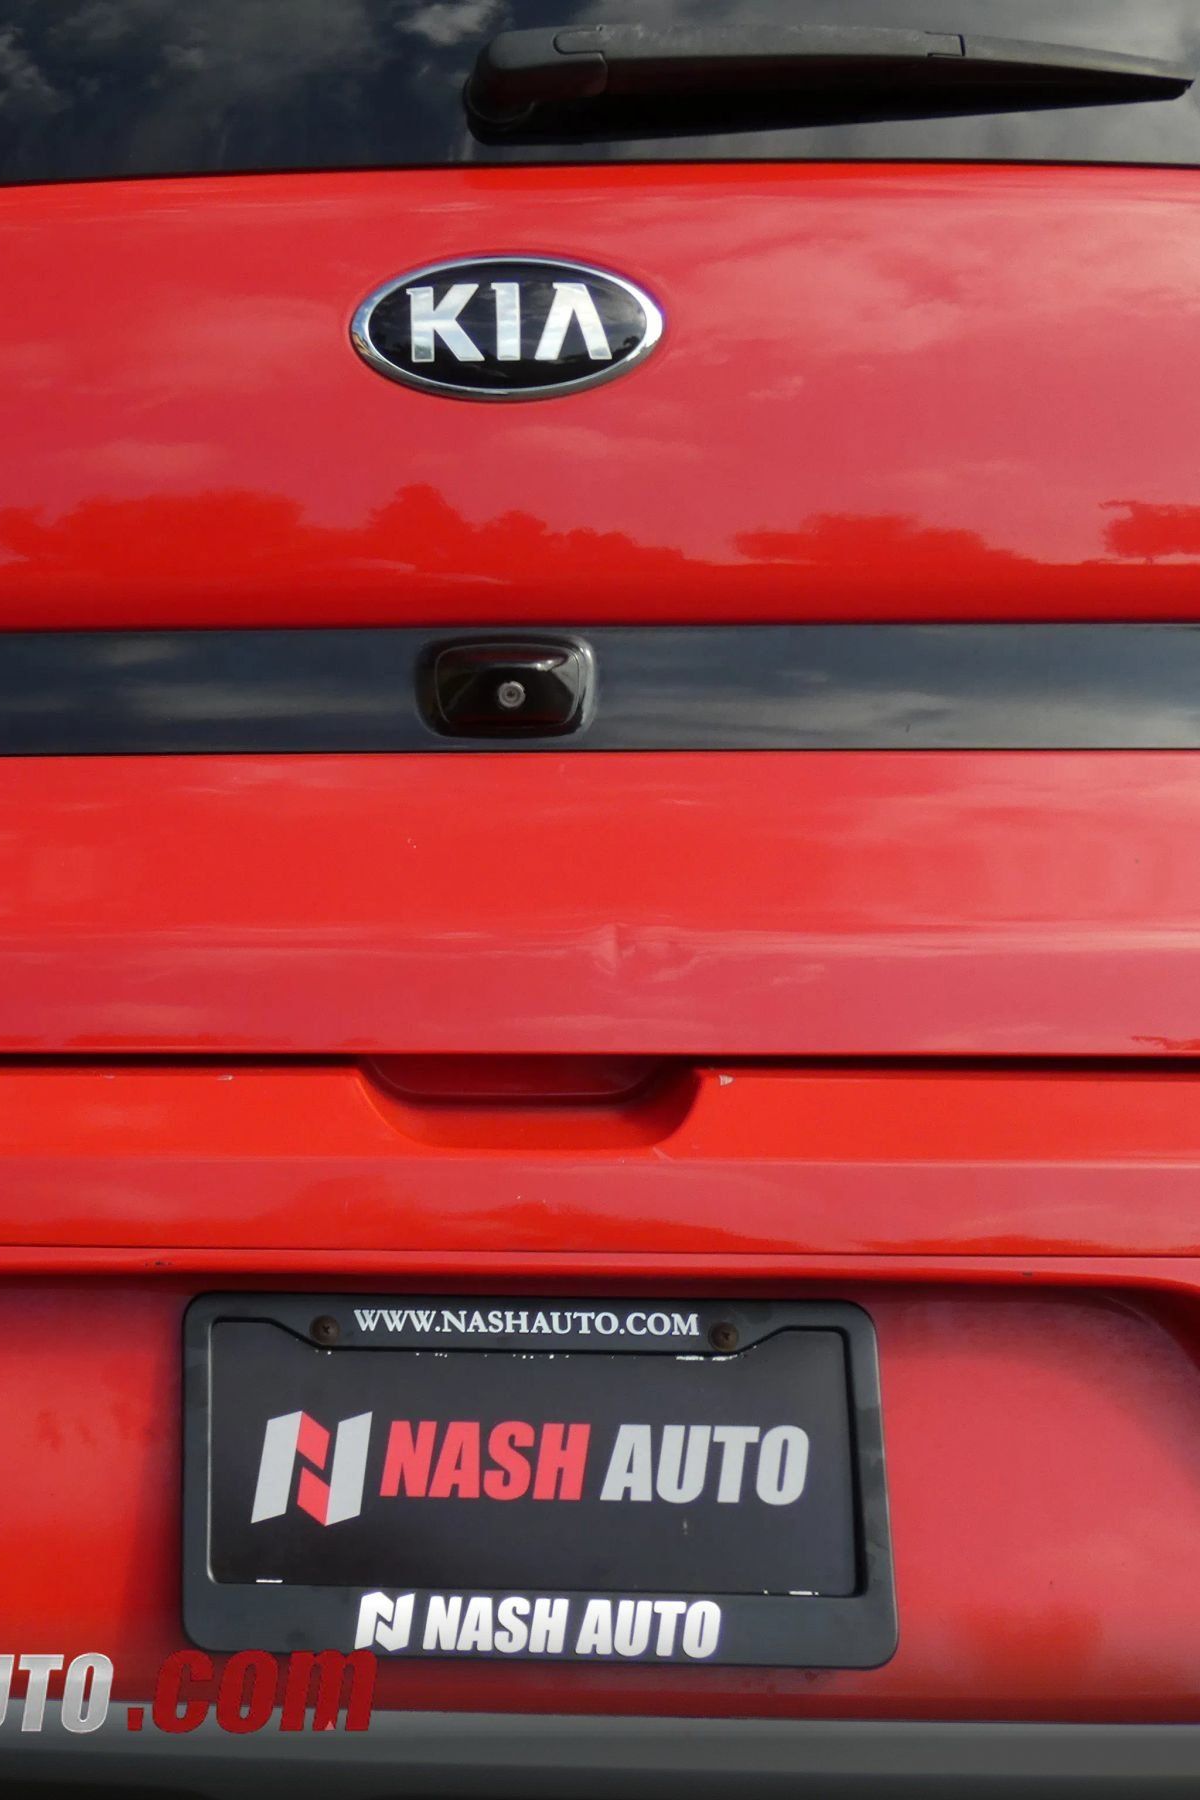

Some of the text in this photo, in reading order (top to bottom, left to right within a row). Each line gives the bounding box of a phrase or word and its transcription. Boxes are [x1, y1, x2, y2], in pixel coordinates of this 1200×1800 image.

[406, 282, 613, 362] KIA
[354, 1309, 700, 1336] WWW.NASHAUTO.COM
[379, 1420, 591, 1501] NASH
[600, 1424, 810, 1505] AUTO
[423, 1595, 570, 1654] NASH
[575, 1600, 722, 1659] AUTO
